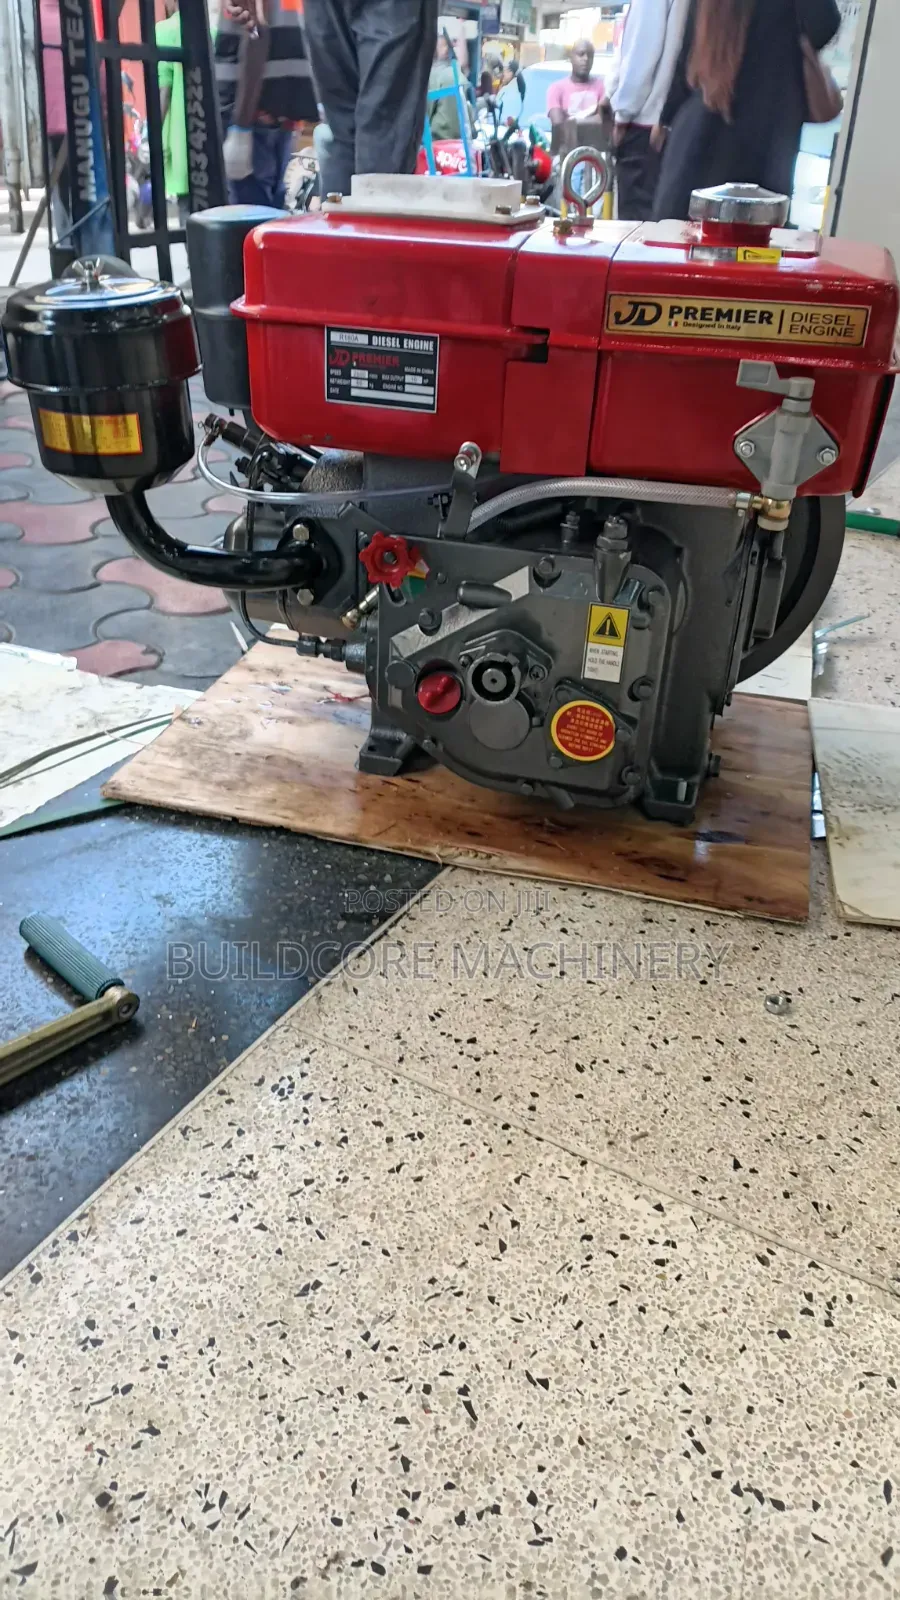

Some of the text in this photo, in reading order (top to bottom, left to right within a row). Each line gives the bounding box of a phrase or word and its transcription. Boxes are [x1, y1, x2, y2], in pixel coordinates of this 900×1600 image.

[71, 74, 97, 203] MANUGU
[613, 300, 774, 327] JD PREMIER
[790, 311, 856, 326] DIESEL
[683, 321, 717, 330] Designed
[726, 323, 742, 331] Italy
[789, 324, 855, 338] ENGINE
[372, 335, 434, 351] DIESEL ENGINE
[351, 352, 400, 367] PREMIER
